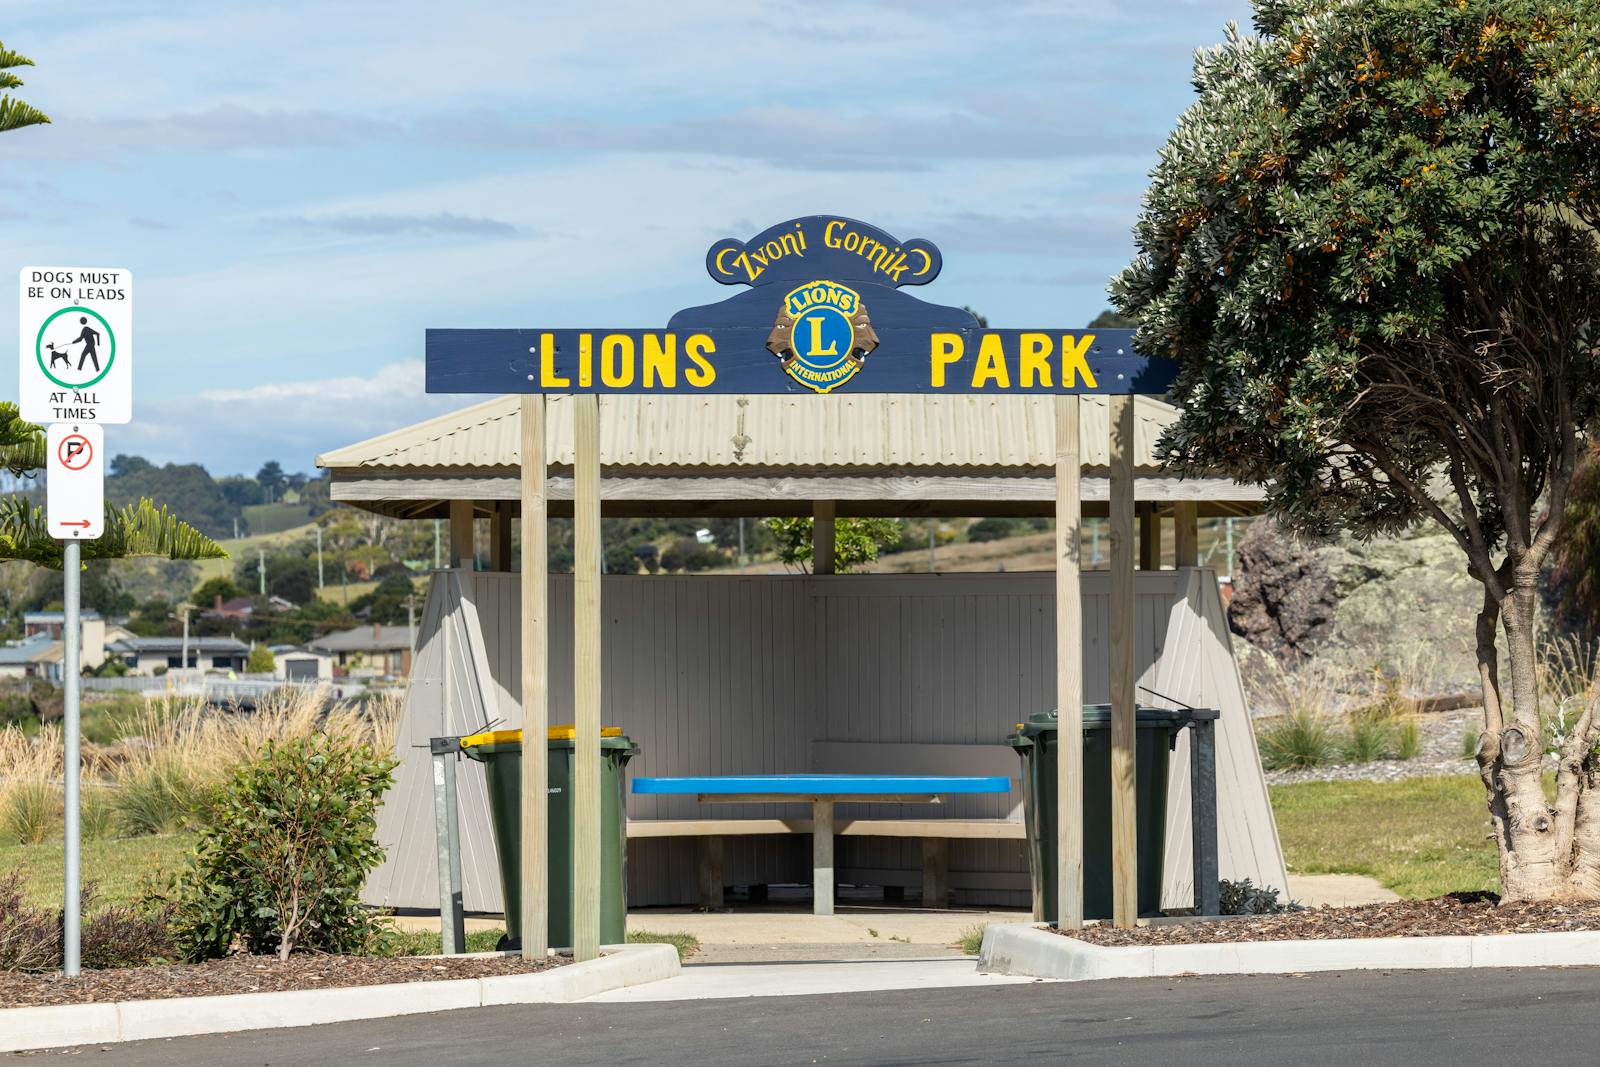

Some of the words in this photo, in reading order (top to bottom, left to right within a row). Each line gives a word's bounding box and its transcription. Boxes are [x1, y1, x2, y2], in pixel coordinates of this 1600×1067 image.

[732, 223, 807, 282] Zvoni
[824, 220, 910, 282] Gornik
[32, 271, 73, 284] DOGS
[80, 272, 120, 285] MUST
[28, 287, 44, 298] BE
[50, 287, 71, 299] ON
[79, 288, 125, 301] LEADS
[791, 287, 854, 311] LIONS
[806, 316, 838, 356] L
[540, 333, 717, 388] LIONS
[930, 333, 1098, 388] PARK
[789, 360, 857, 383] INTERNATIONAL
[49, 392, 67, 403] AT
[73, 392, 100, 404] ALL
[53, 407, 96, 419] TIMES
[67, 441, 84, 463] P
